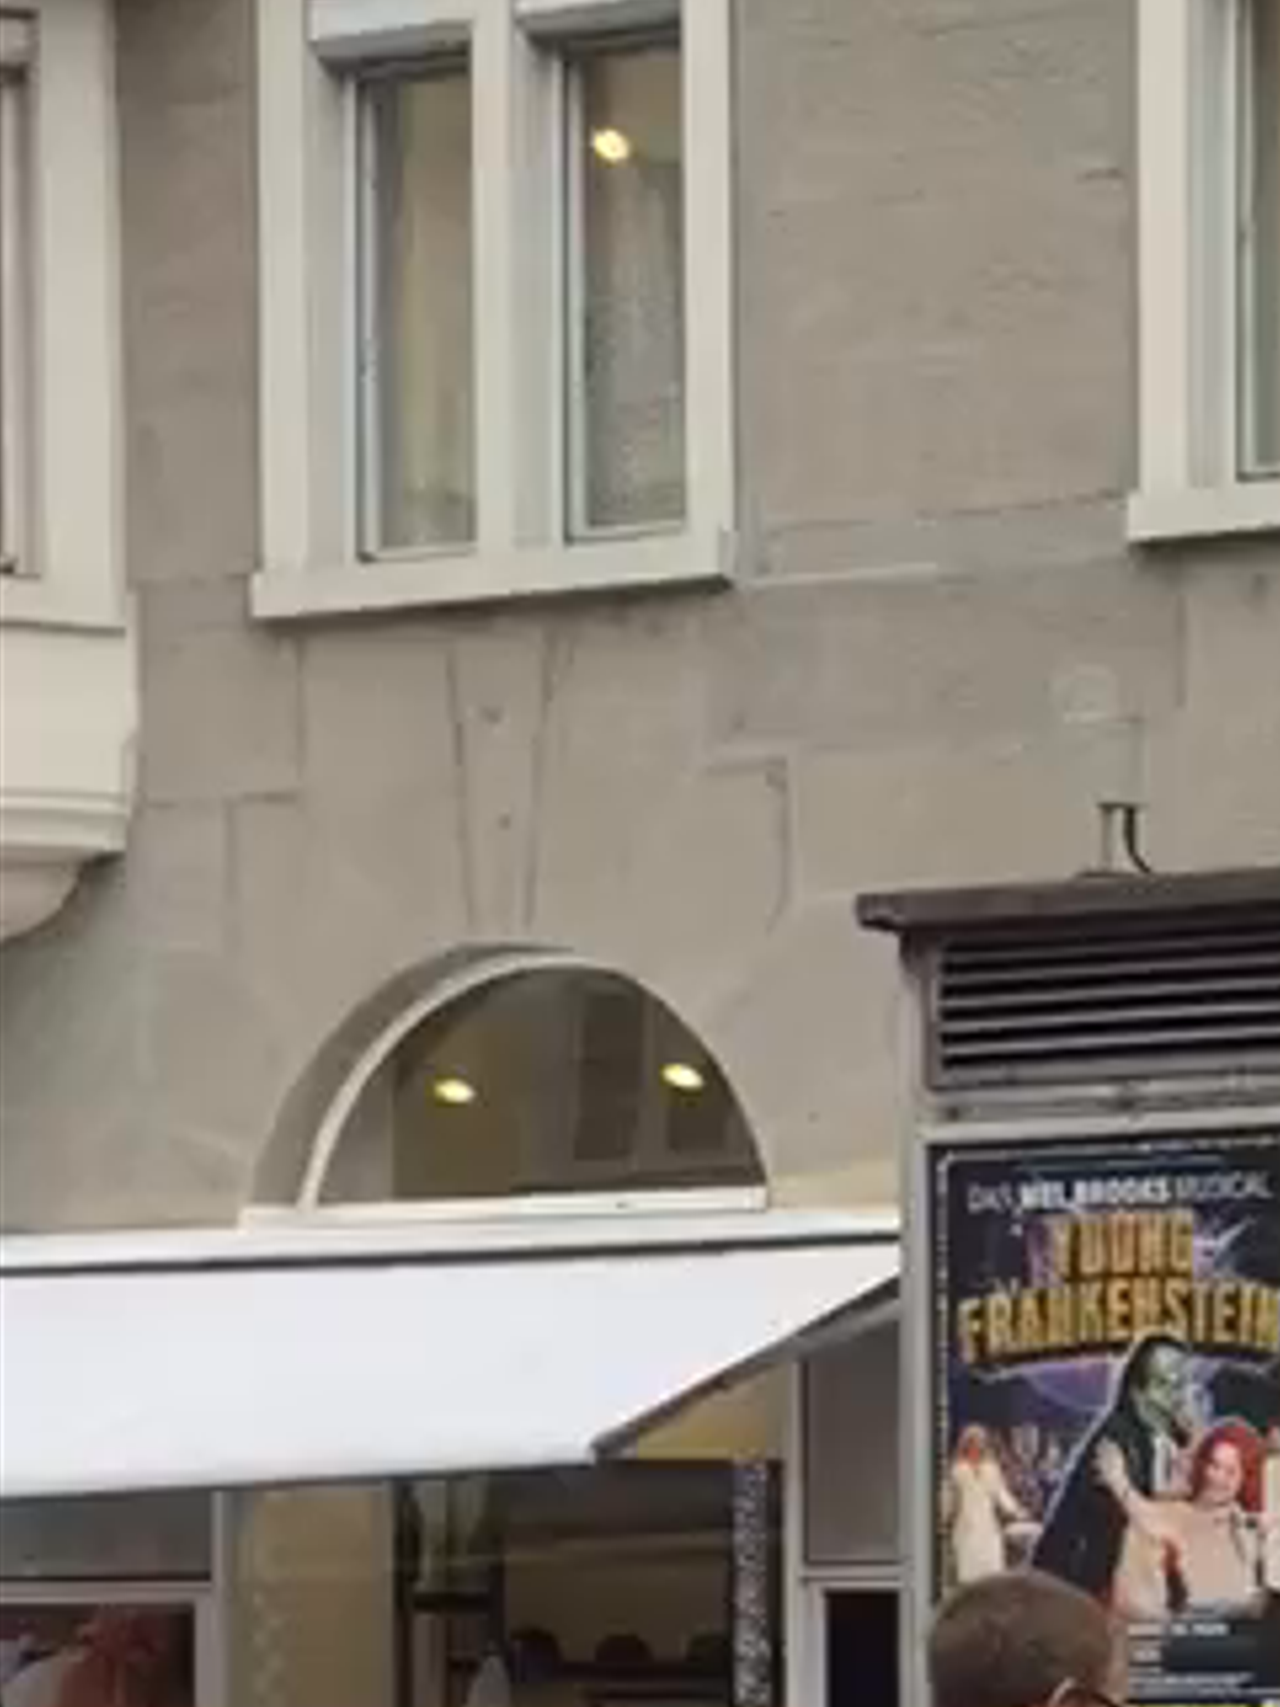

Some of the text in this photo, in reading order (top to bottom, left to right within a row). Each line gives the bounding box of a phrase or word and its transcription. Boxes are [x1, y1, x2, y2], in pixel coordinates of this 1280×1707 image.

[967, 1184, 1012, 1214] DAS
[1072, 1177, 1171, 1206] BROOKS
[1047, 1209, 1196, 1275] YOUNG
